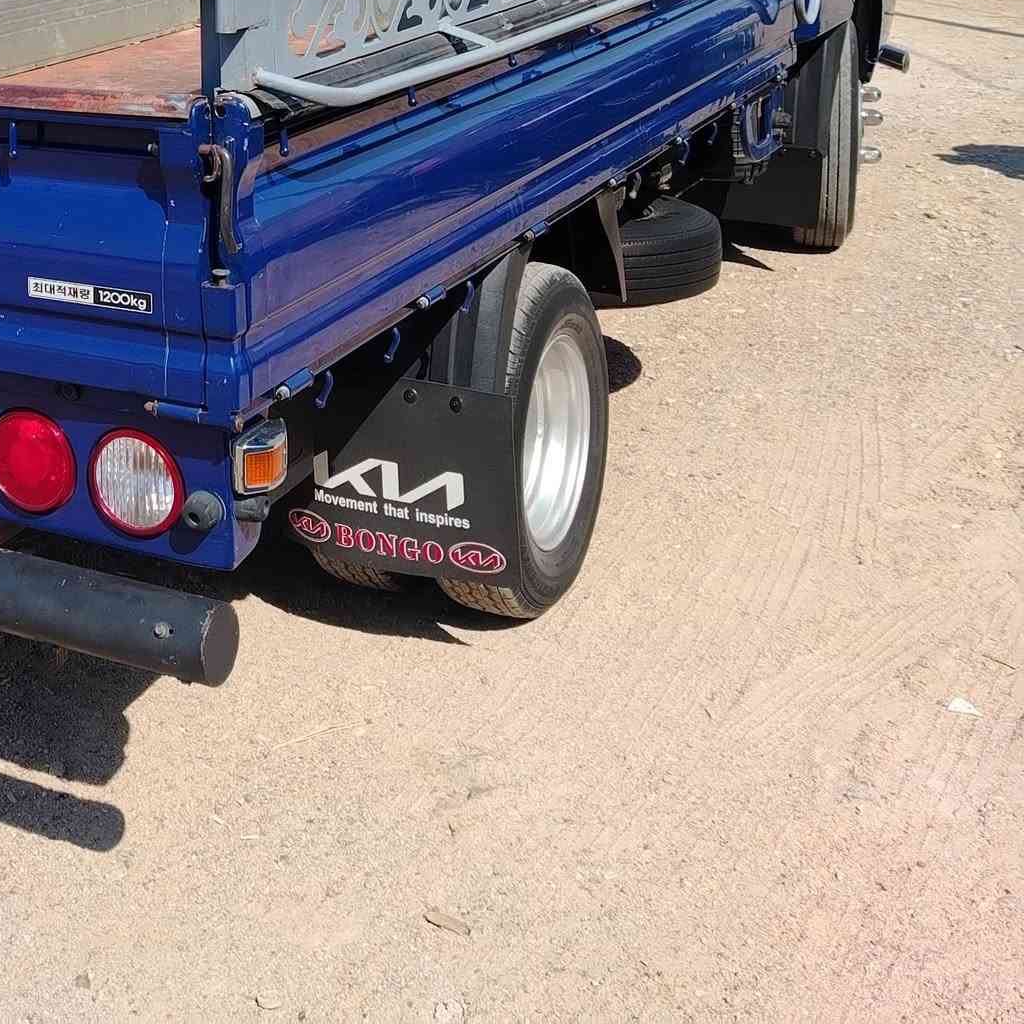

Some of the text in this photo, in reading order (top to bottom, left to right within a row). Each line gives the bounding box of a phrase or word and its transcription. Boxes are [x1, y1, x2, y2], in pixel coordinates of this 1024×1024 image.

[31, 280, 91, 301] 최대적재량
[97, 288, 147, 311] 1200kg
[313, 450, 465, 511] KIA
[314, 488, 471, 530] Movement that inspires
[334, 522, 445, 564] BONGO
